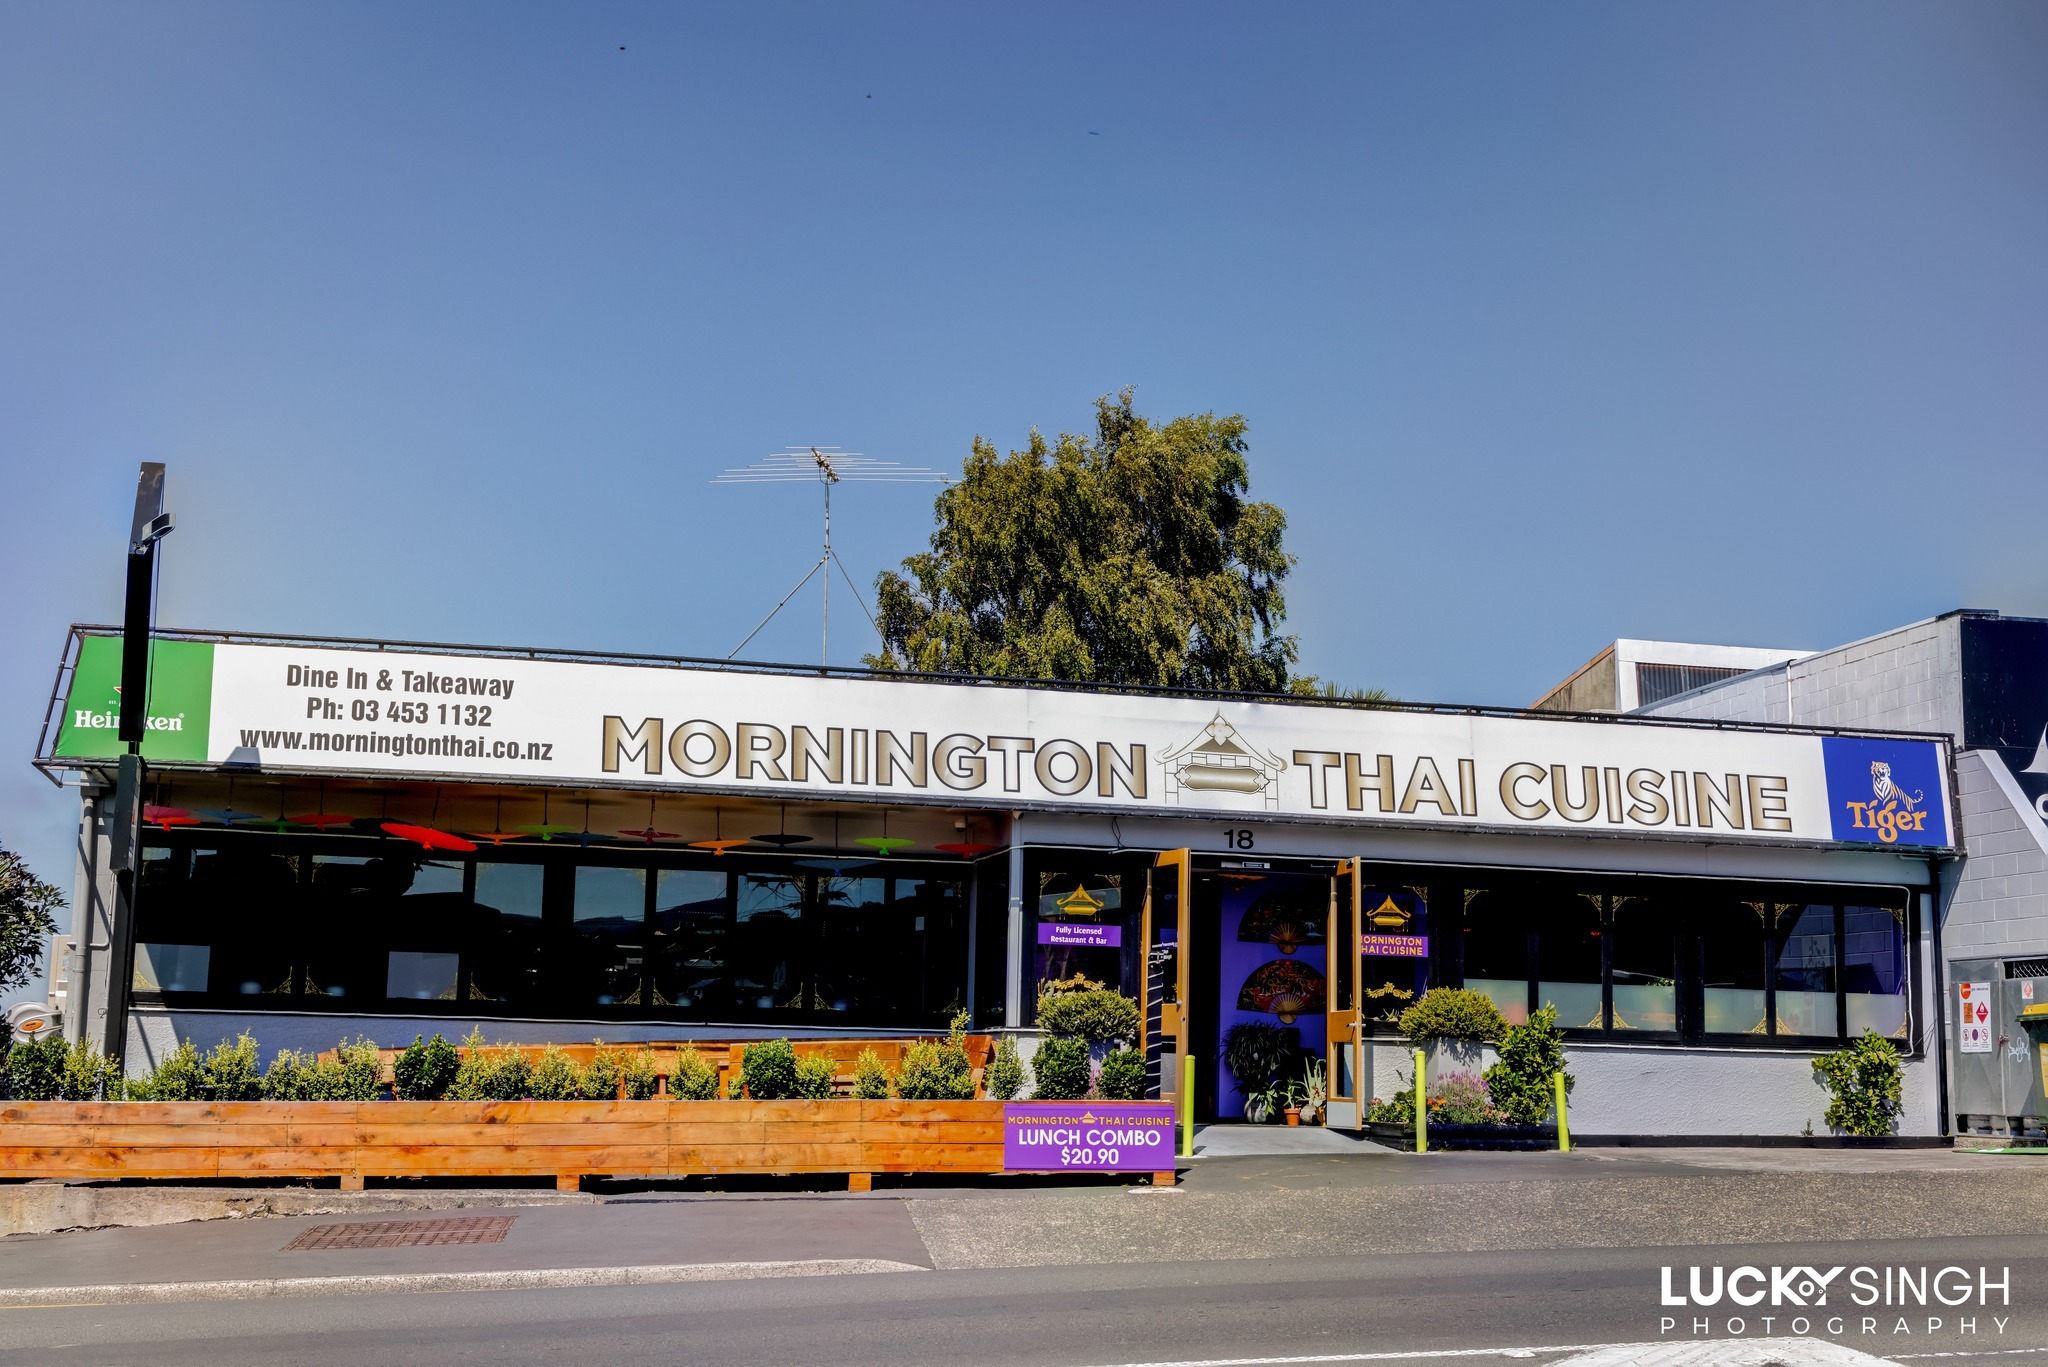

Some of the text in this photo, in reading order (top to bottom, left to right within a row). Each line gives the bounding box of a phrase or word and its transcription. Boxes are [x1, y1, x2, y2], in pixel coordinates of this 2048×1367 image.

[286, 664, 515, 700] Dine In & Takeaway
[306, 696, 493, 727] Ph: 03 453 1132
[239, 729, 554, 761] www.morningtonthai.co.nz
[601, 715, 1793, 832] MORNINGTON THAI CUISINE
[1846, 799, 1927, 843] Tiger
[1223, 828, 1255, 849] 18
[1050, 935, 1108, 945] Restaurant & Bar
[1055, 926, 1102, 935] Fully Licensed
[1360, 936, 1422, 946] ORNINGTON
[1360, 945, 1423, 956] HAI CUISINE
[1008, 1116, 1171, 1126] MORNINGTON THAI CUISINE
[1018, 1128, 1161, 1146] LUNCH COMBO
[1060, 1146, 1120, 1166] $20.90
